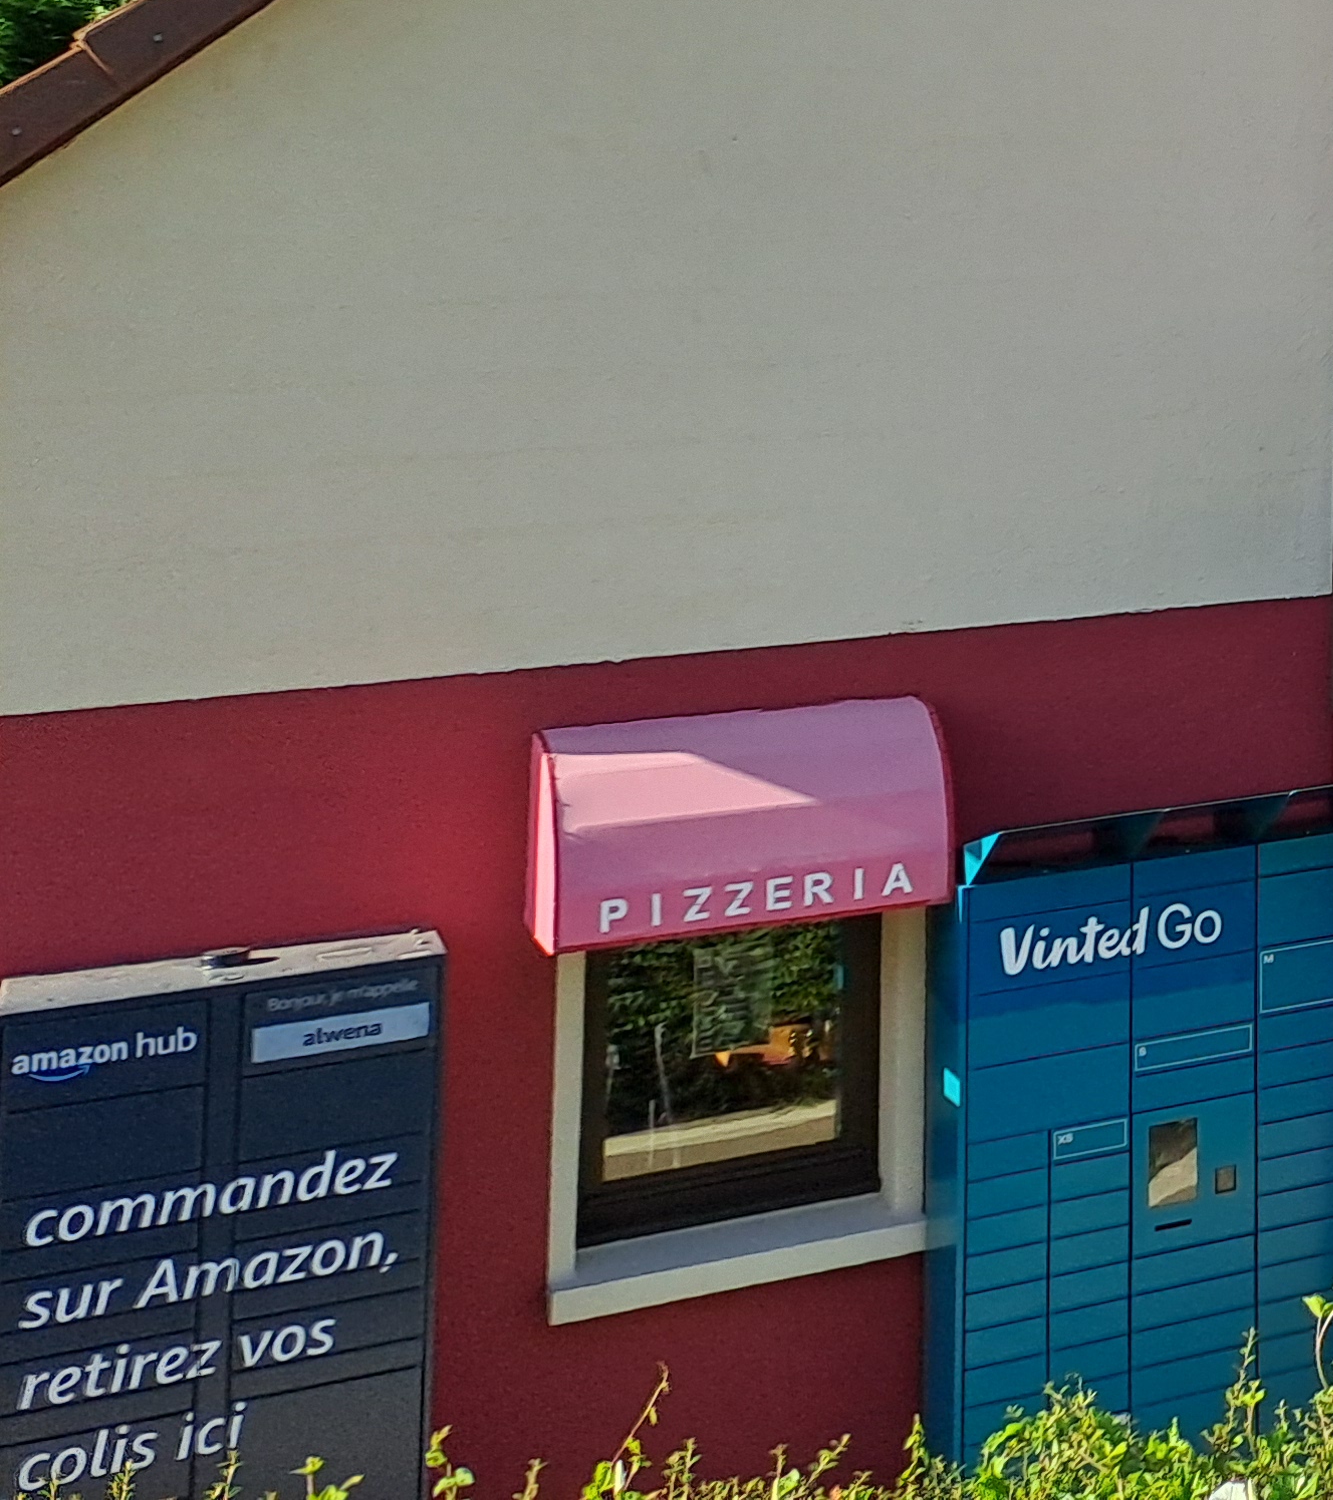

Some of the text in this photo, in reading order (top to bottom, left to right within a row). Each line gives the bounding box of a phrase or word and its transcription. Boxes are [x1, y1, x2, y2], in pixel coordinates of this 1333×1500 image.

[599, 862, 913, 934] PIZZERIA
[1000, 903, 1223, 976] Vinted Go
[1263, 953, 1275, 964] M
[11, 1026, 198, 1075] amazon hub
[302, 1022, 383, 1047] alwena
[22, 1149, 399, 1248] commandez
[18, 1230, 400, 1329] sur Amazon,
[16, 1318, 338, 1411] retirez vos
[17, 1401, 248, 1491] colis ici
